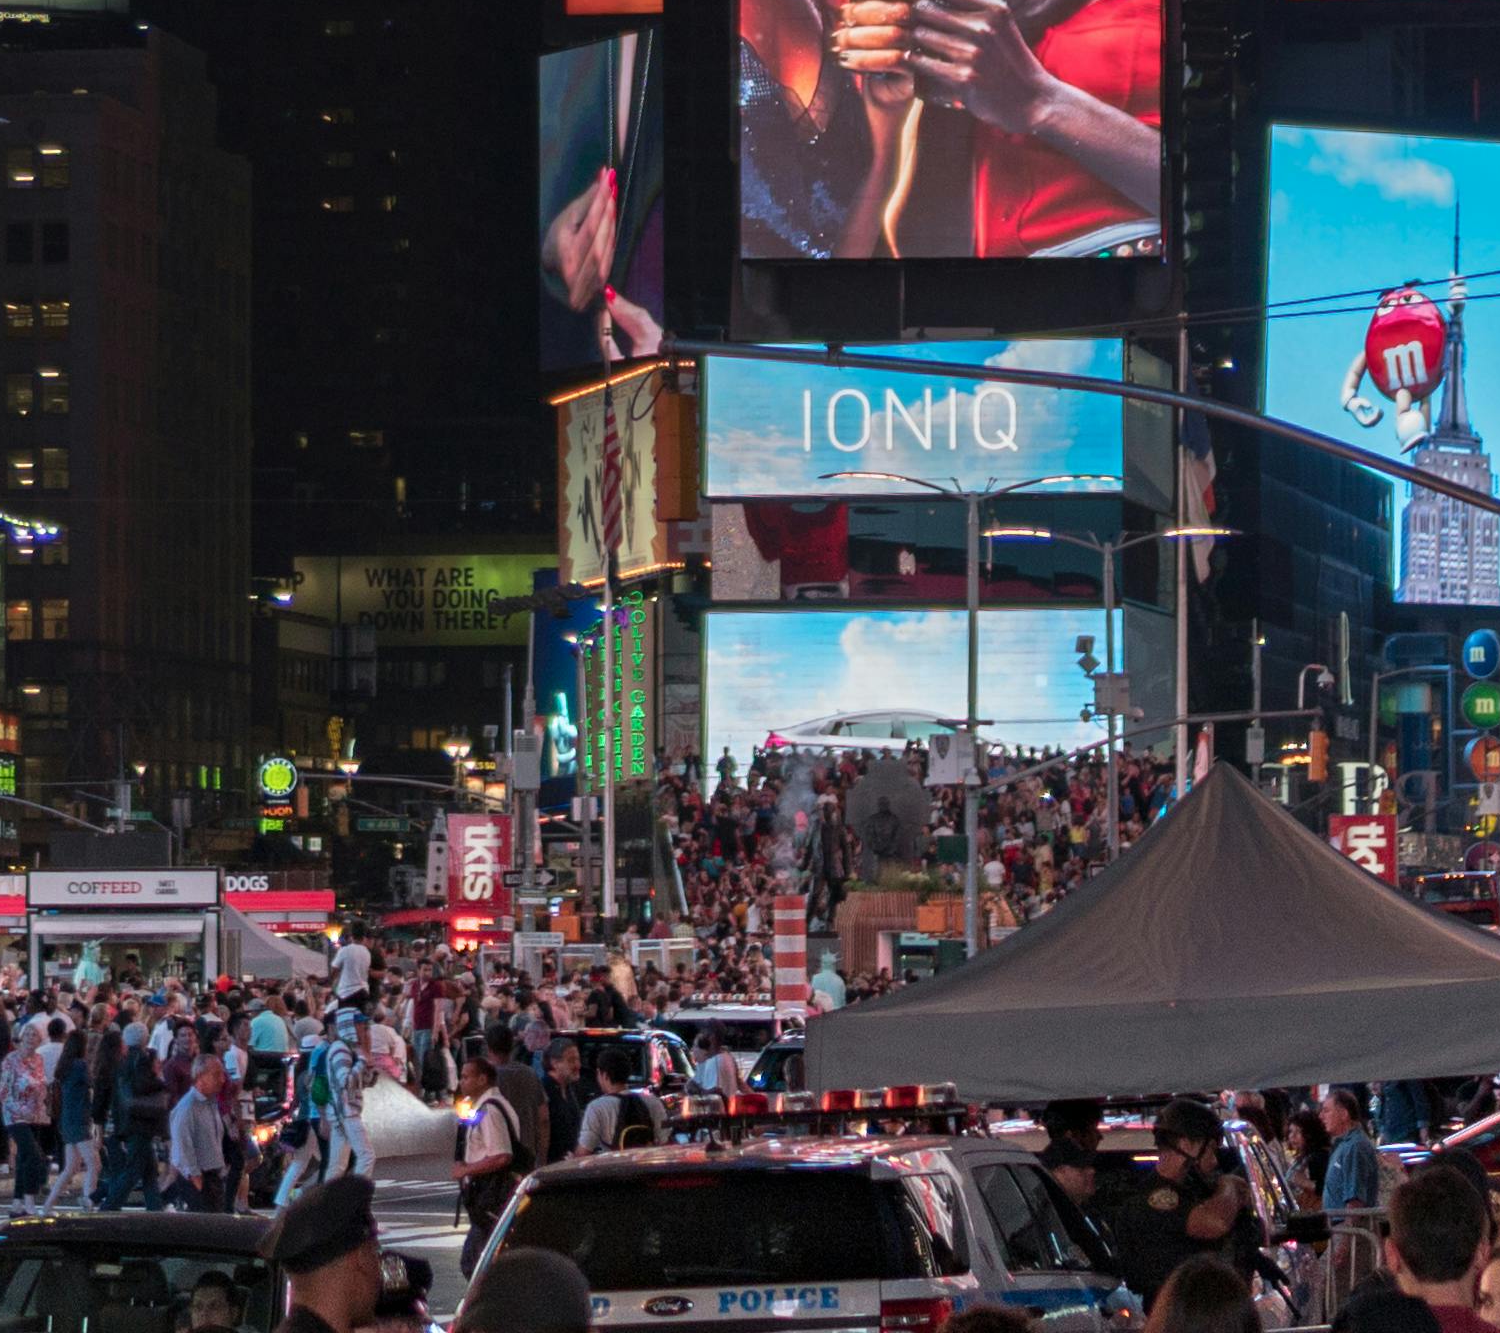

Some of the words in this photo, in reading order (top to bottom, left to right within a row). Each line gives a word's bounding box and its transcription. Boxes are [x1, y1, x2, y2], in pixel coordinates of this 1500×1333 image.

[1383, 340, 1429, 389] m
[801, 387, 1020, 454] IONIQ
[364, 568, 427, 588] WHAT
[432, 568, 474, 587] ARE
[382, 589, 425, 609] YOU
[358, 611, 426, 631] DOWN
[433, 611, 510, 631] THERE?
[630, 608, 647, 684] OLIVE
[630, 688, 647, 776] GARDEN
[464, 821, 501, 901] tkts
[67, 881, 143, 895] COFFEED
[225, 875, 269, 892] DOGS
[717, 1285, 840, 1316] POLICE
